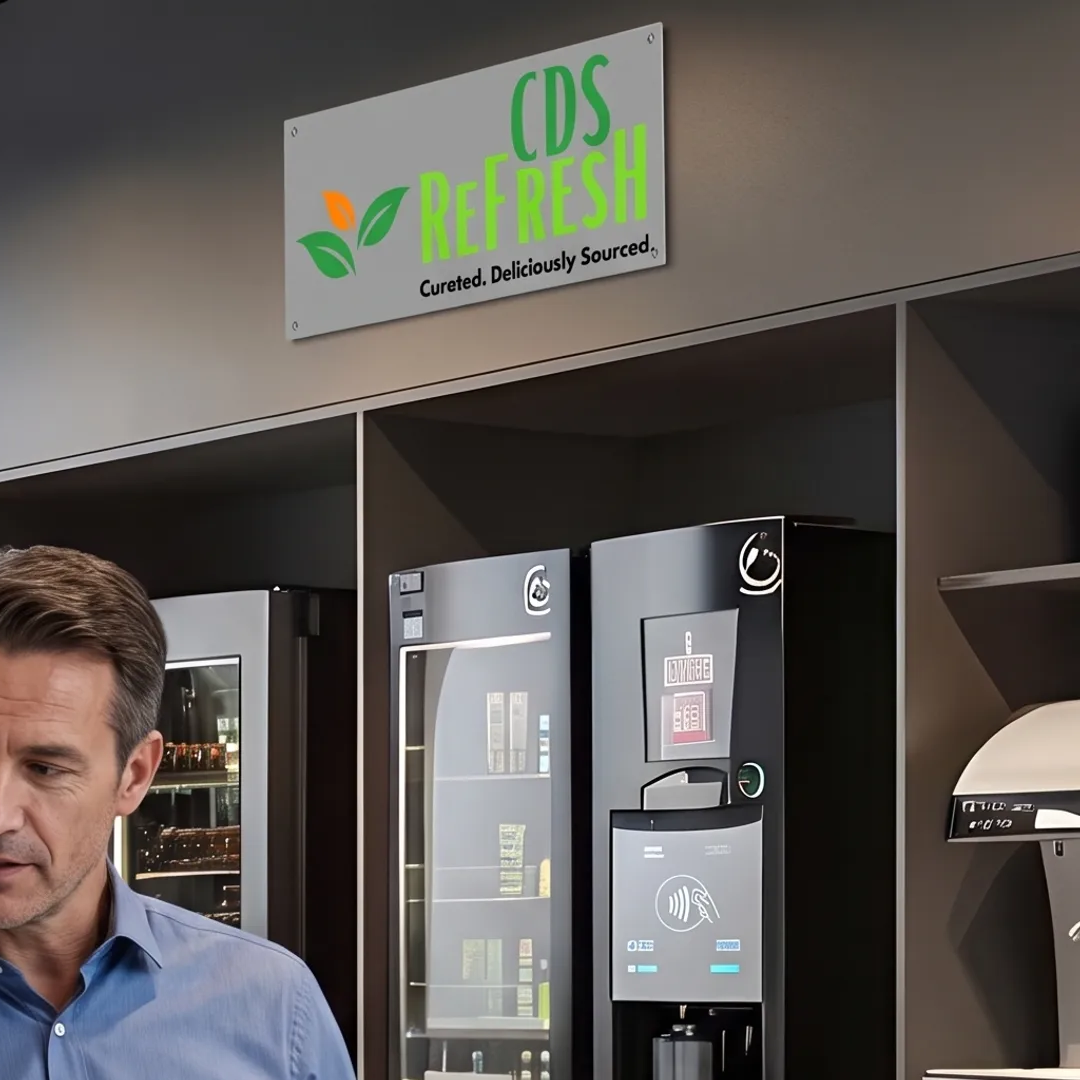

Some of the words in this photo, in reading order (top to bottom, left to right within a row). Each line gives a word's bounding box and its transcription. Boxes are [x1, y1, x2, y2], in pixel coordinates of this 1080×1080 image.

[511, 54, 611, 161] CDS
[420, 267, 487, 298] Cureted.
[491, 250, 577, 284] Deliciously
